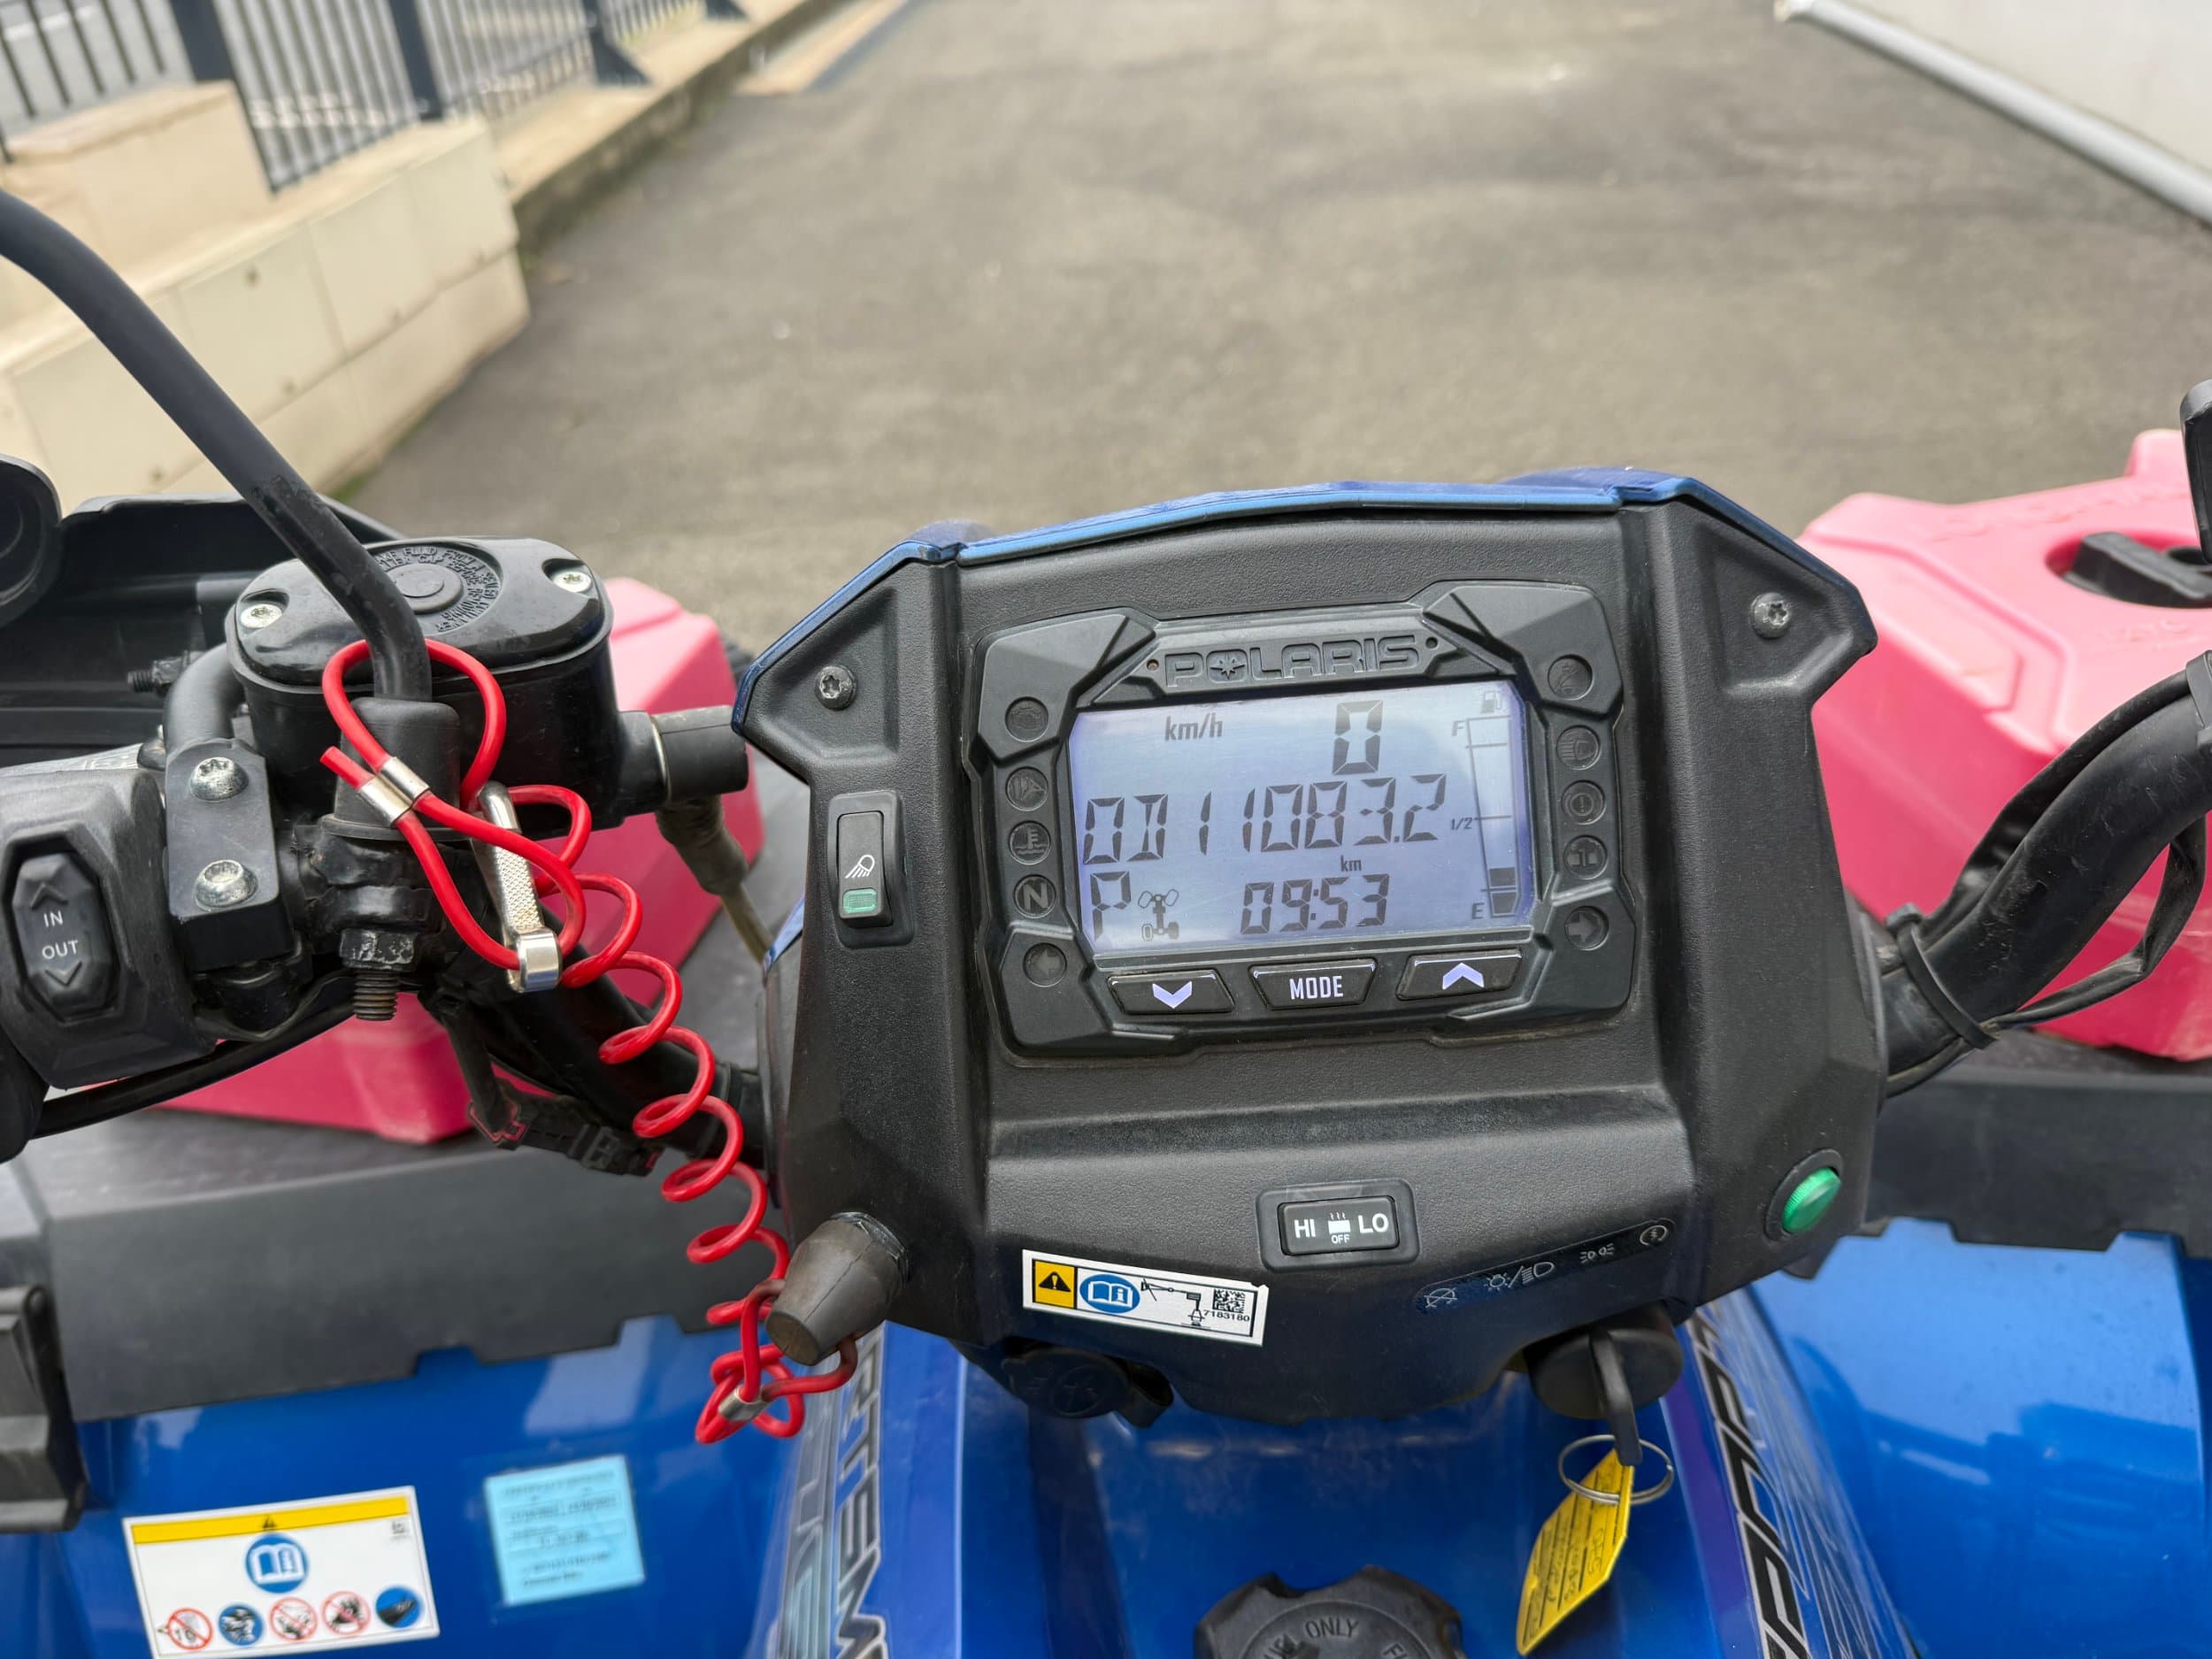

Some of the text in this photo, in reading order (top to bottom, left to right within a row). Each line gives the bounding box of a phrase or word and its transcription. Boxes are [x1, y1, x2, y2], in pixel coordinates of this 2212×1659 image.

[1164, 634, 1419, 688] POLARIS
[1164, 712, 1223, 741] km/h
[1332, 699, 1383, 775] 0
[1452, 720, 1466, 737] F
[1450, 817, 1473, 832] 1/2
[1340, 856, 1363, 872] km
[1022, 882, 1049, 910] N
[1090, 871, 1132, 941] P
[1240, 872, 1390, 935] 09:53
[43, 910, 64, 928] IN
[1471, 902, 1485, 920] E
[42, 939, 79, 960] OUT
[1289, 975, 1344, 1000] MODE
[1294, 1212, 1389, 1239] HI LO
[1331, 1234, 1350, 1245] OFF
[1203, 1309, 1250, 1322] 7183180
[1304, 1617, 1360, 1639] ONLY
